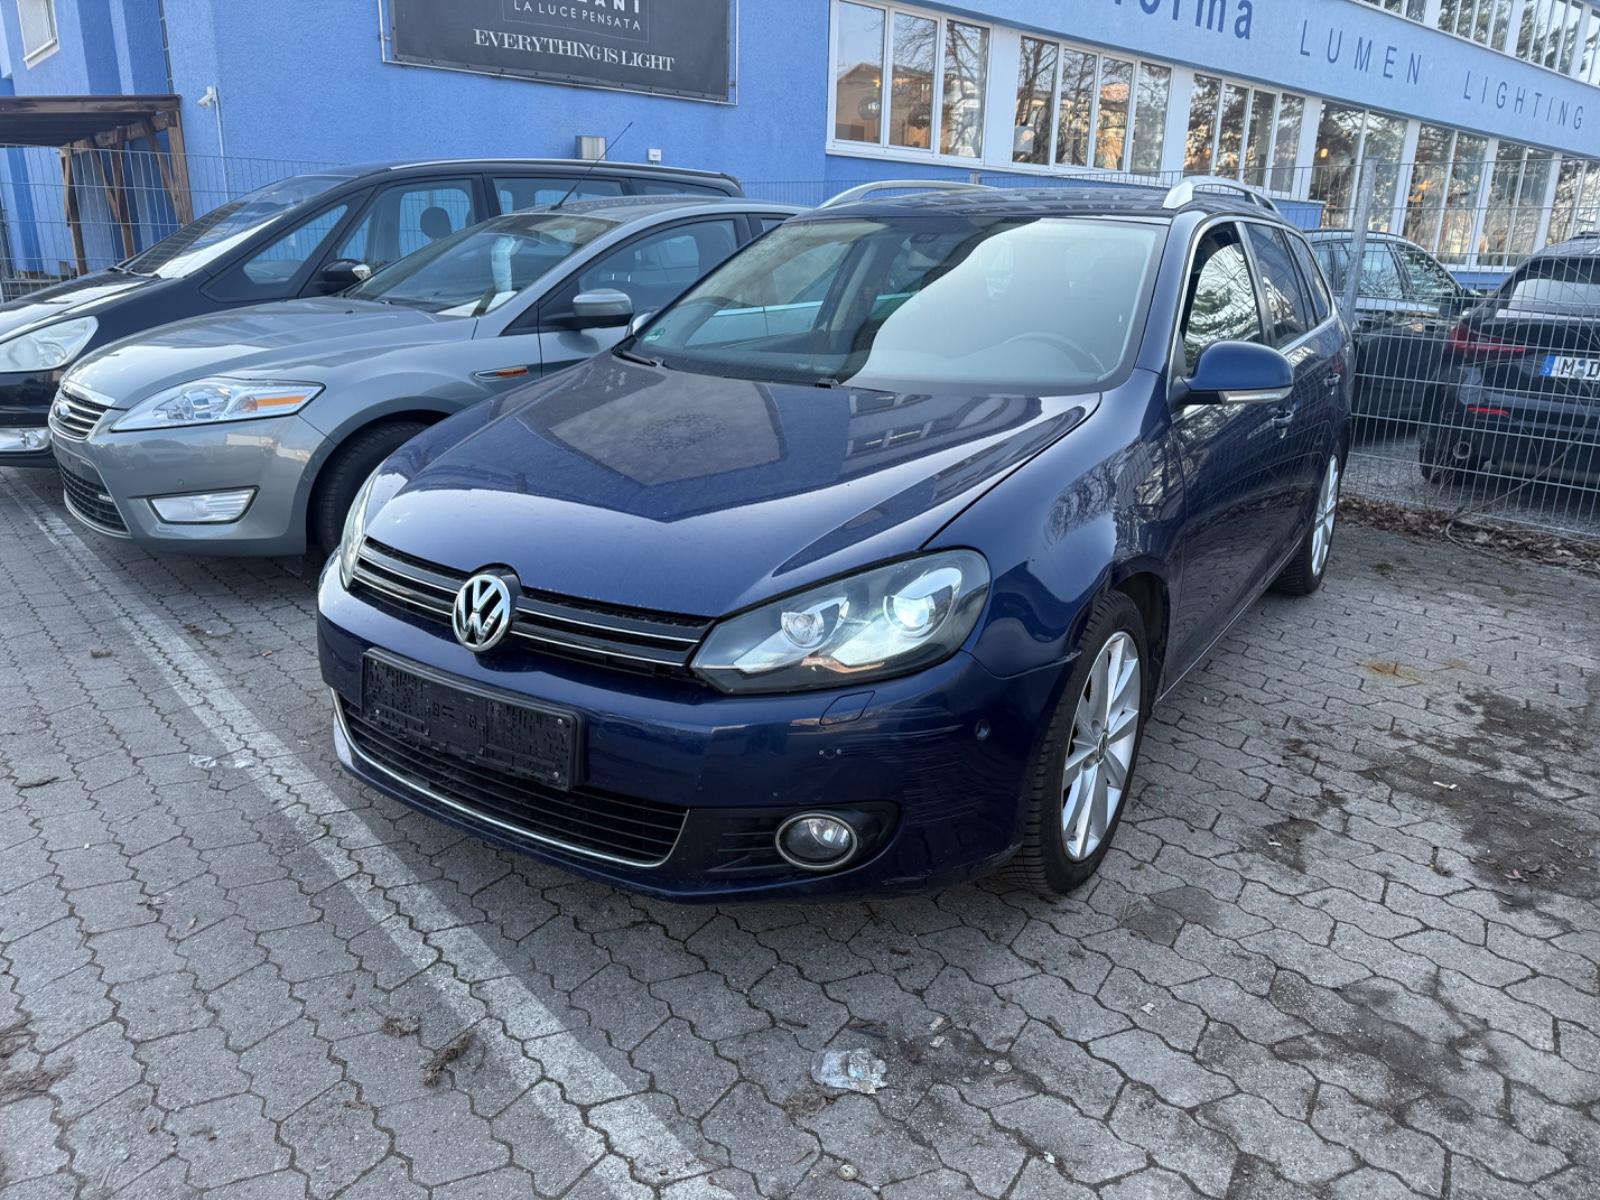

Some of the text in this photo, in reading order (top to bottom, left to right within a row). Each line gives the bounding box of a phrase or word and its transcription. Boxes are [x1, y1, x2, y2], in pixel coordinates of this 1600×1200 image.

[513, 0, 641, 31] LA LUCE PENSATA
[577, 0, 640, 14] ANI
[473, 28, 675, 72] EVERYTHING IS LIGHT
[1300, 19, 1423, 85] LUMEN
[1463, 70, 1584, 130] LIGHTING
[452, 574, 511, 652] VW
